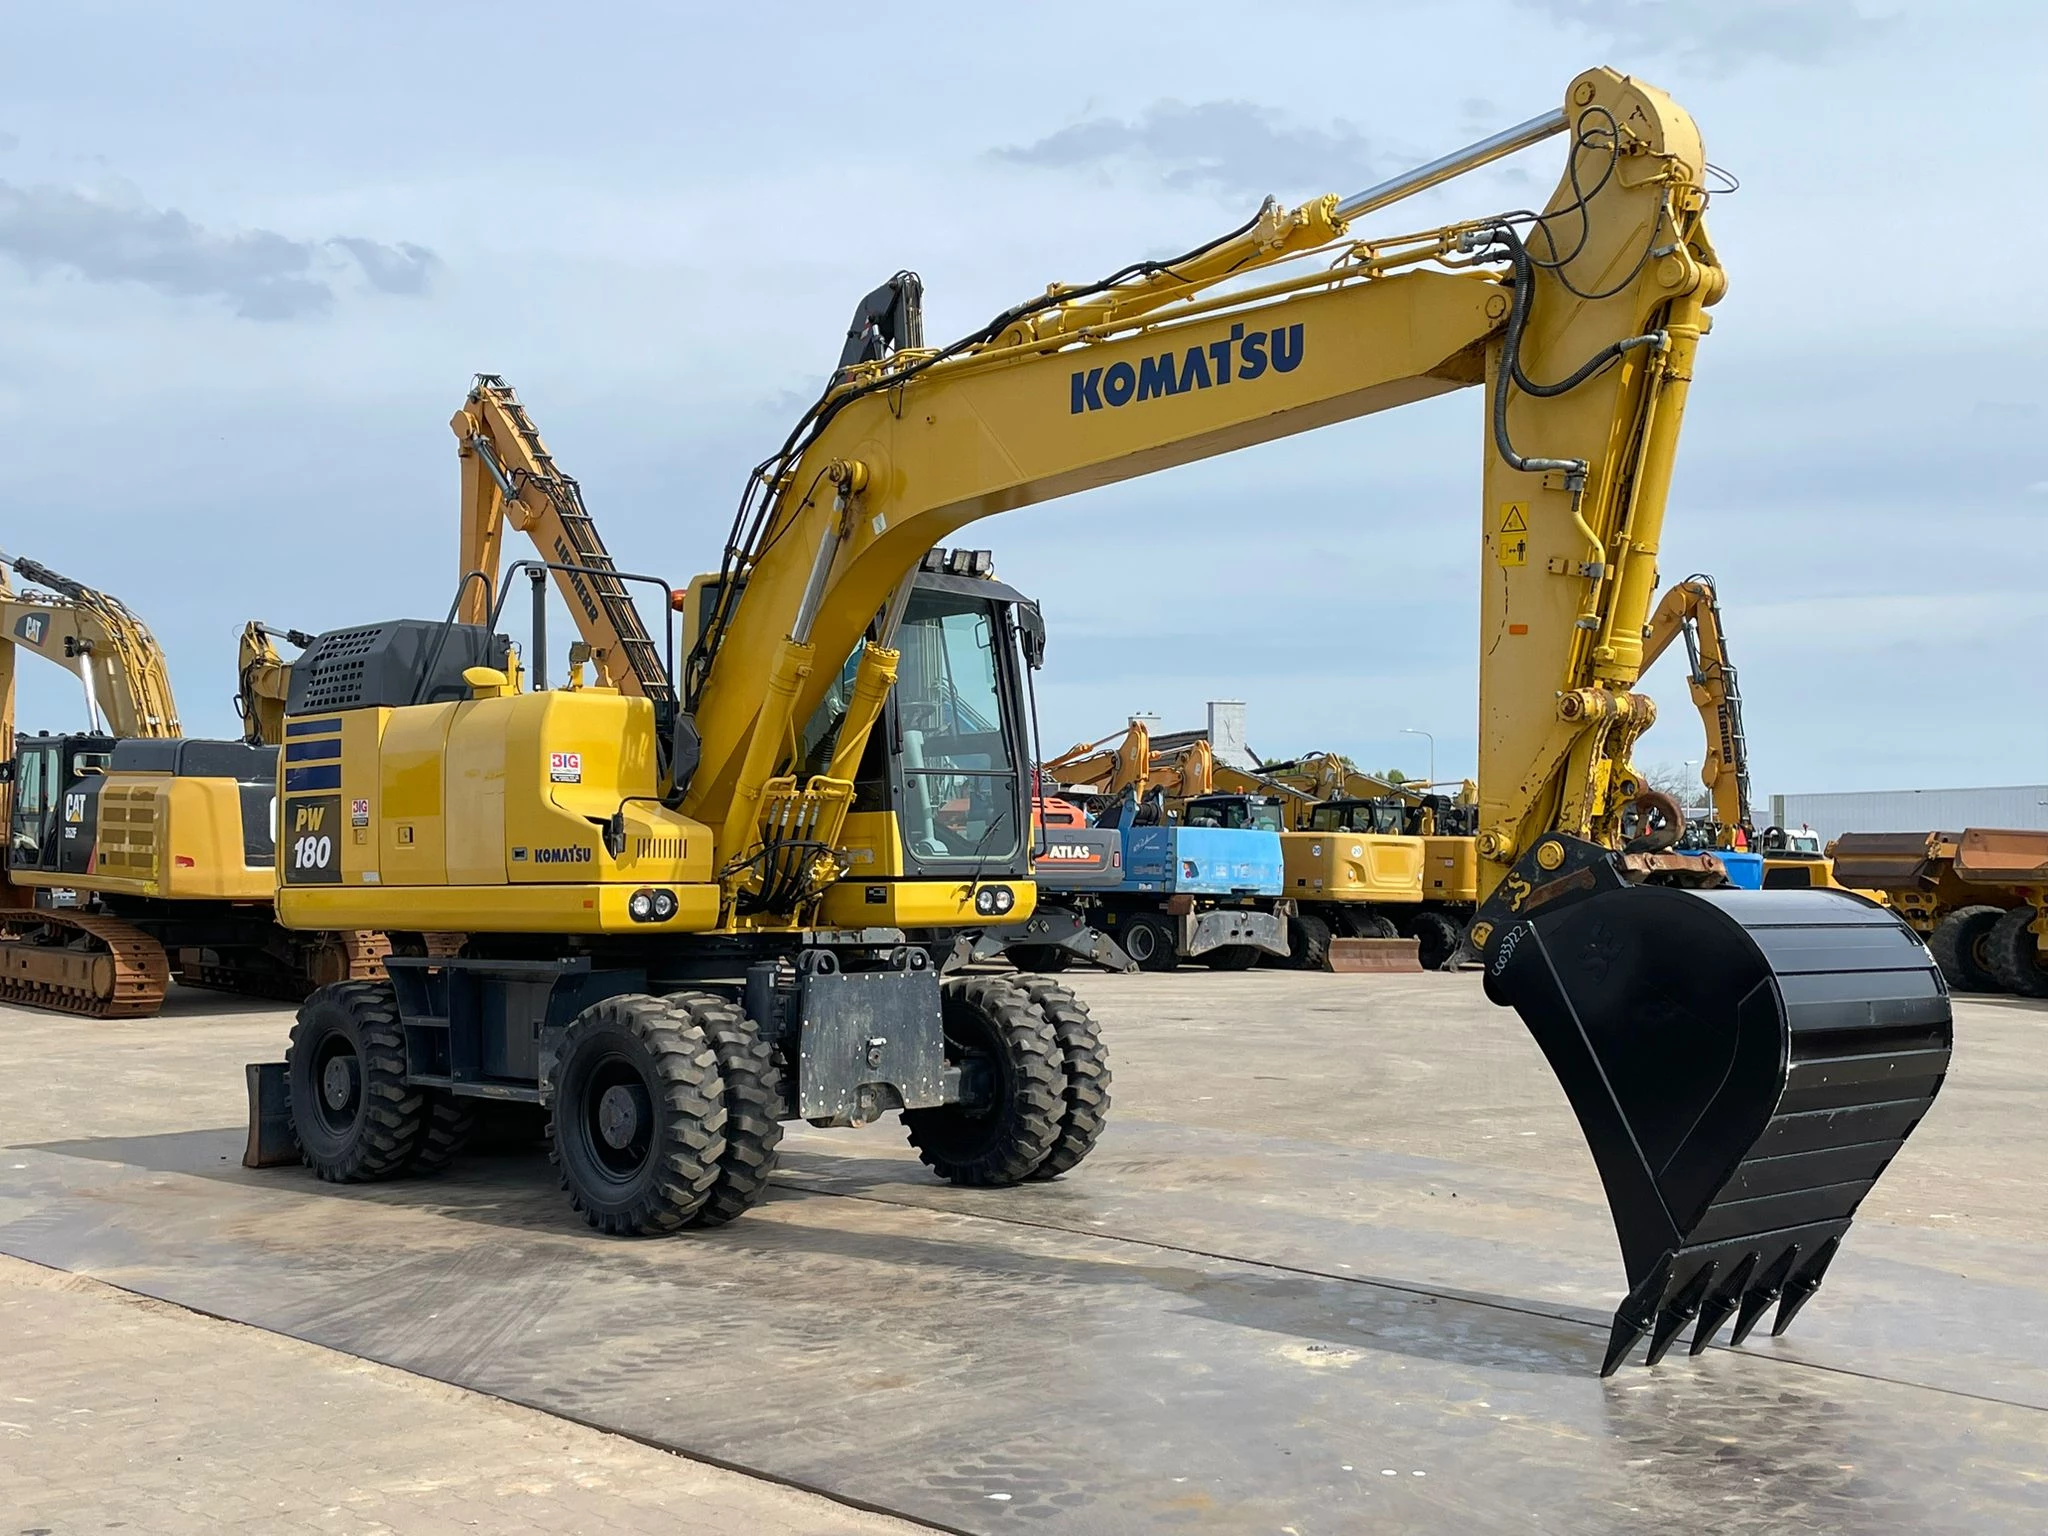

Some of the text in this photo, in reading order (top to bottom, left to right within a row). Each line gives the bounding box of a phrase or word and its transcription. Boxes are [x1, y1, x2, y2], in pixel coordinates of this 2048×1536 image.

[1071, 323, 1304, 414] KOMATSU
[25, 616, 41, 643] CAT
[1718, 704, 1732, 764] LIEBHERR
[66, 794, 86, 822] CAT
[295, 807, 325, 832] PW
[295, 836, 331, 868] 180
[535, 844, 591, 862] KOMATSU
[1049, 846, 1089, 859] ATLAS
